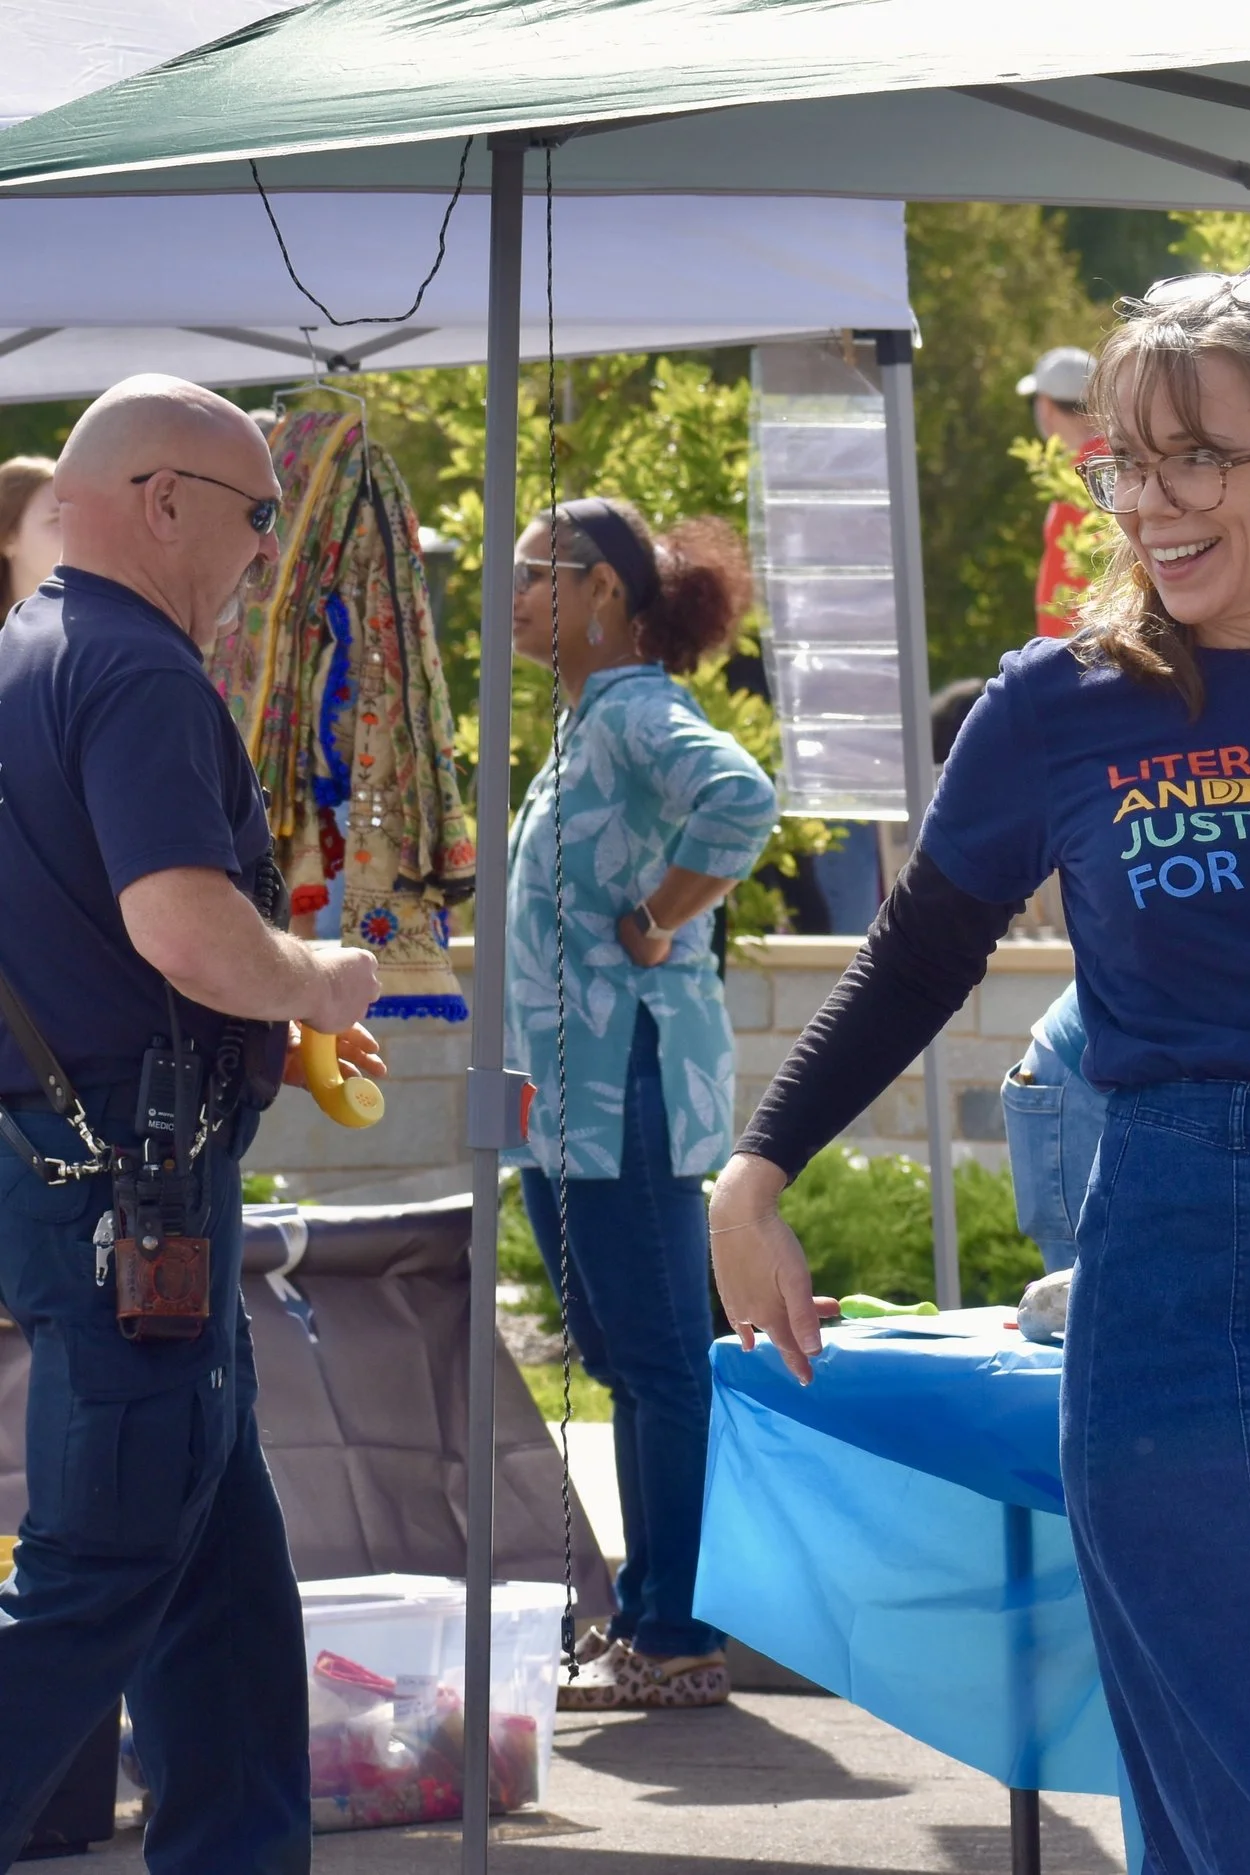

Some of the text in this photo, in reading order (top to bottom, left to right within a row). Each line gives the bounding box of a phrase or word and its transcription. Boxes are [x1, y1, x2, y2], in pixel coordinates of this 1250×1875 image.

[1113, 778, 1243, 824] AND
[1127, 850, 1244, 910] FOR
[148, 1119, 175, 1131] MEDIC
